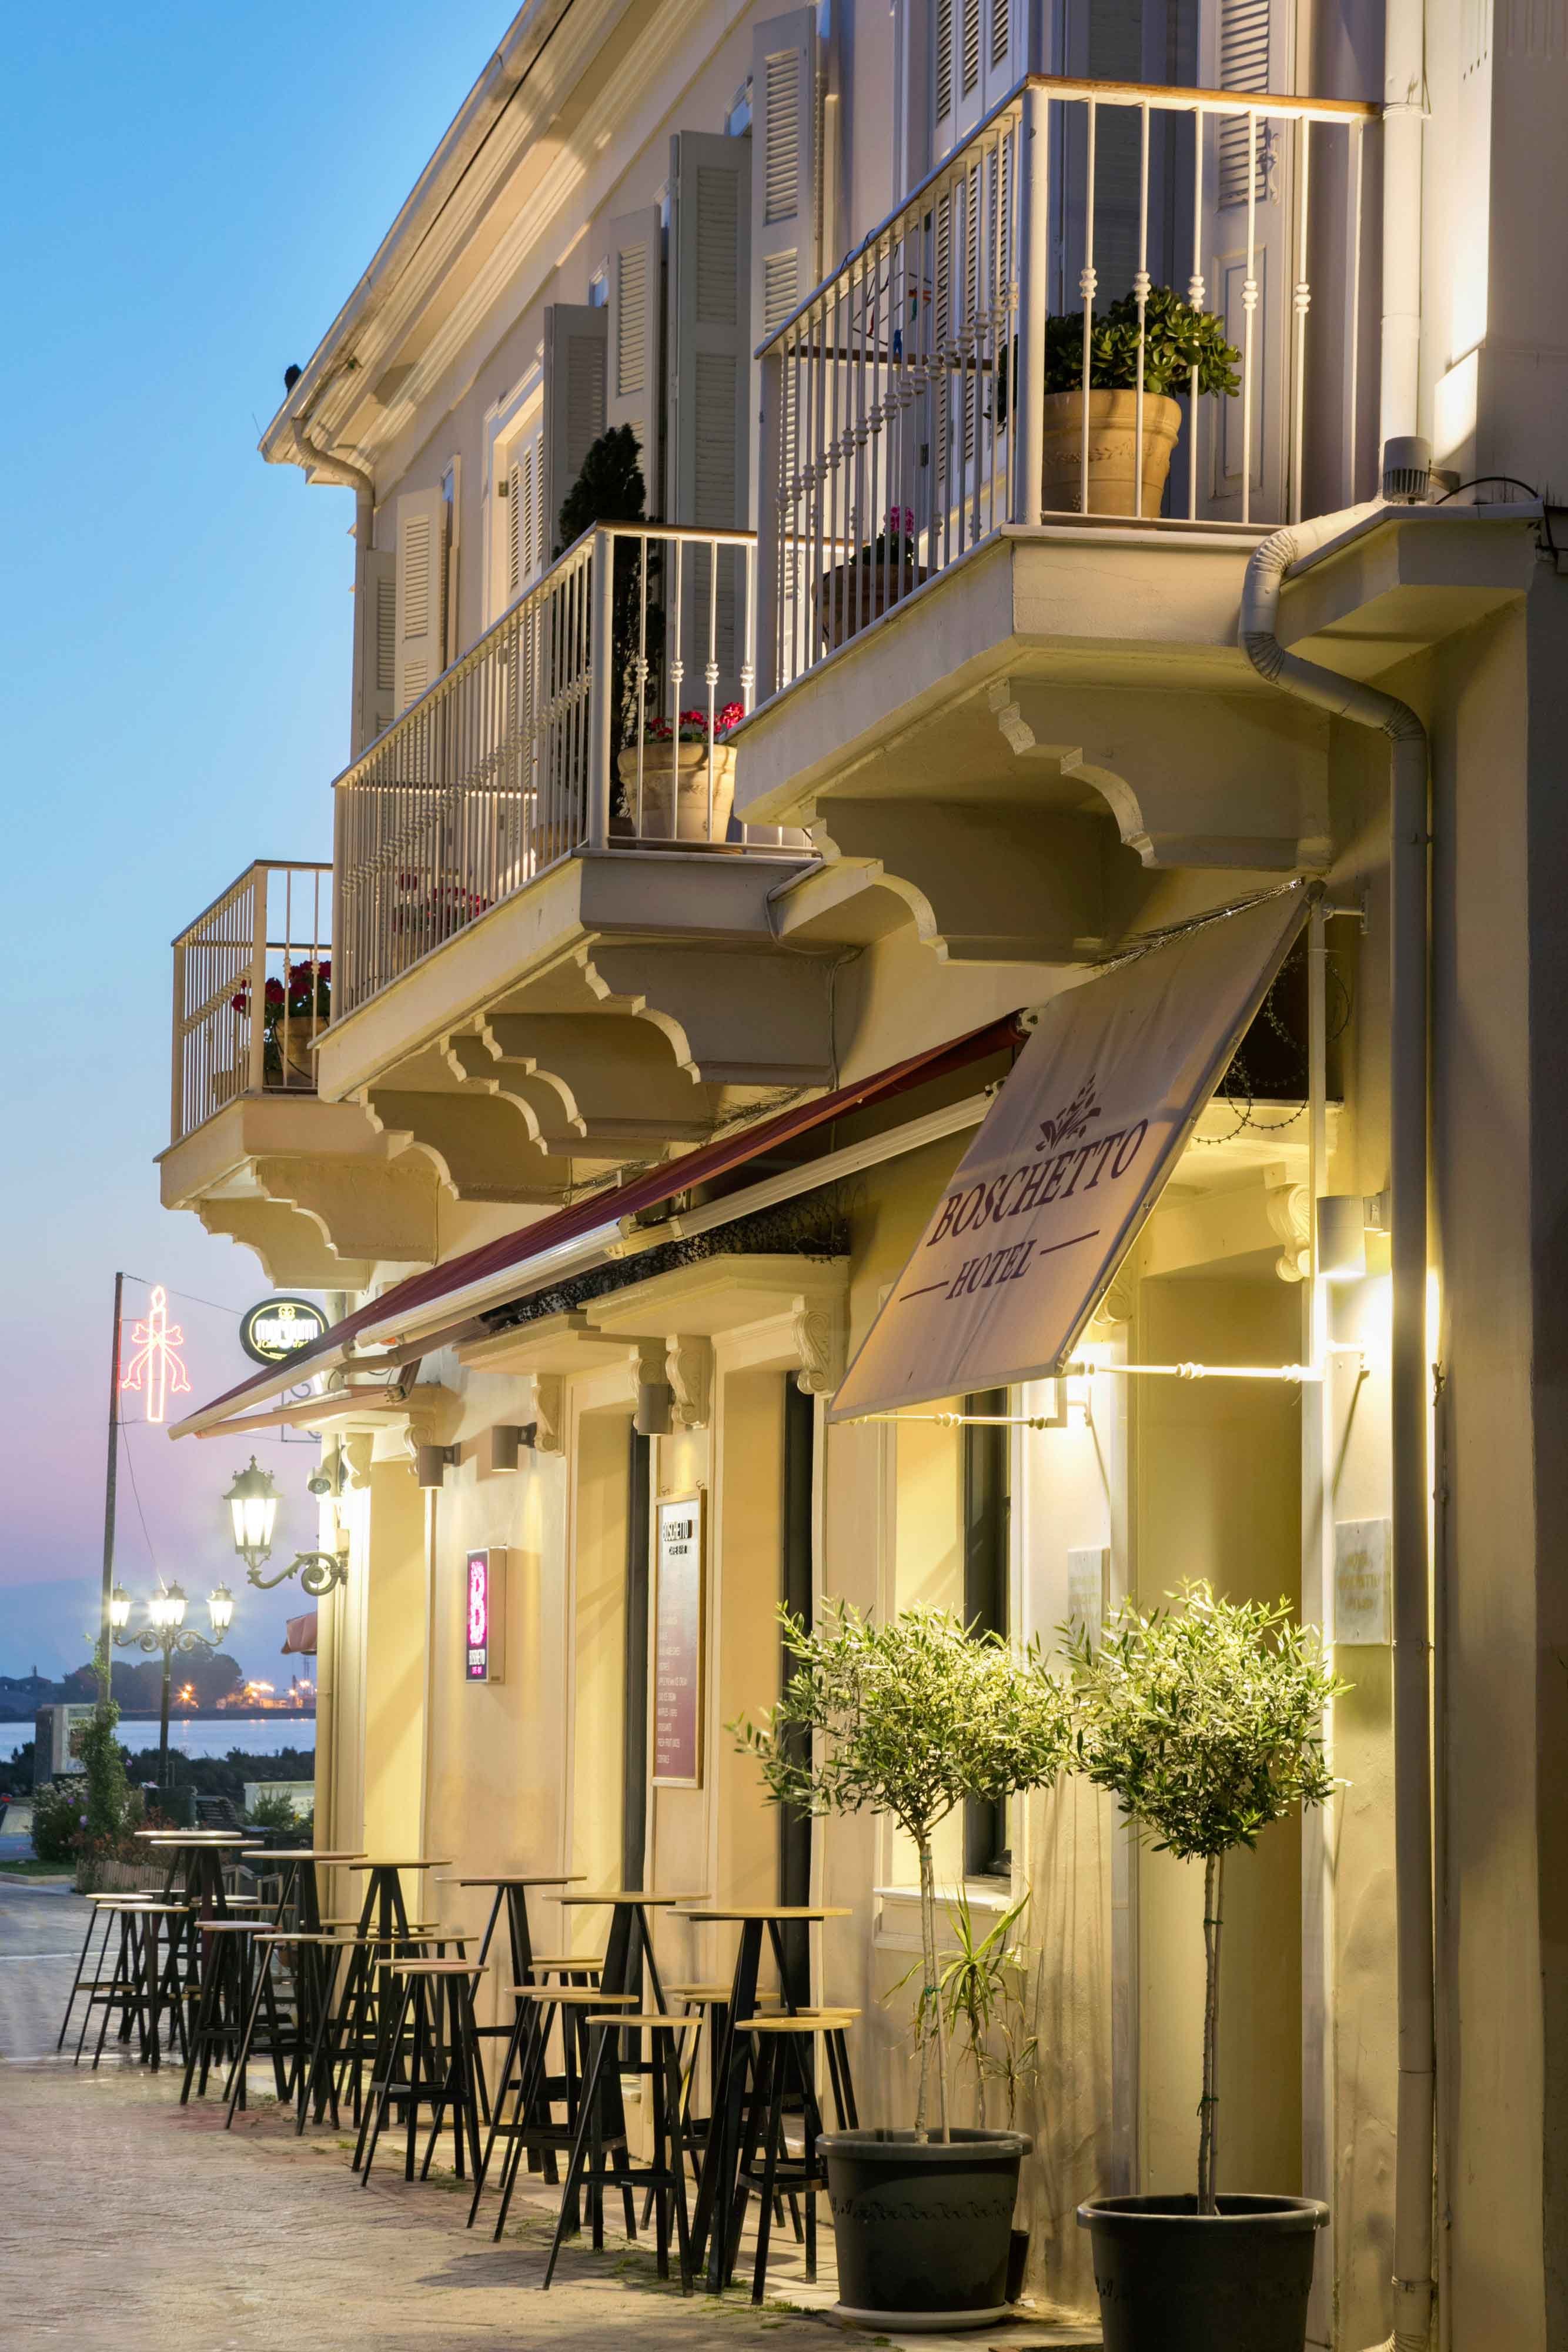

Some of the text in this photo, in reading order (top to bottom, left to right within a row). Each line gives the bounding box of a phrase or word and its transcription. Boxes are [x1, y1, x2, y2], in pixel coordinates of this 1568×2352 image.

[927, 1118, 1149, 1247] BOSCHETTO
[945, 1238, 1037, 1300] HOTEL
[663, 1519, 689, 1542] BOSCHETTO
